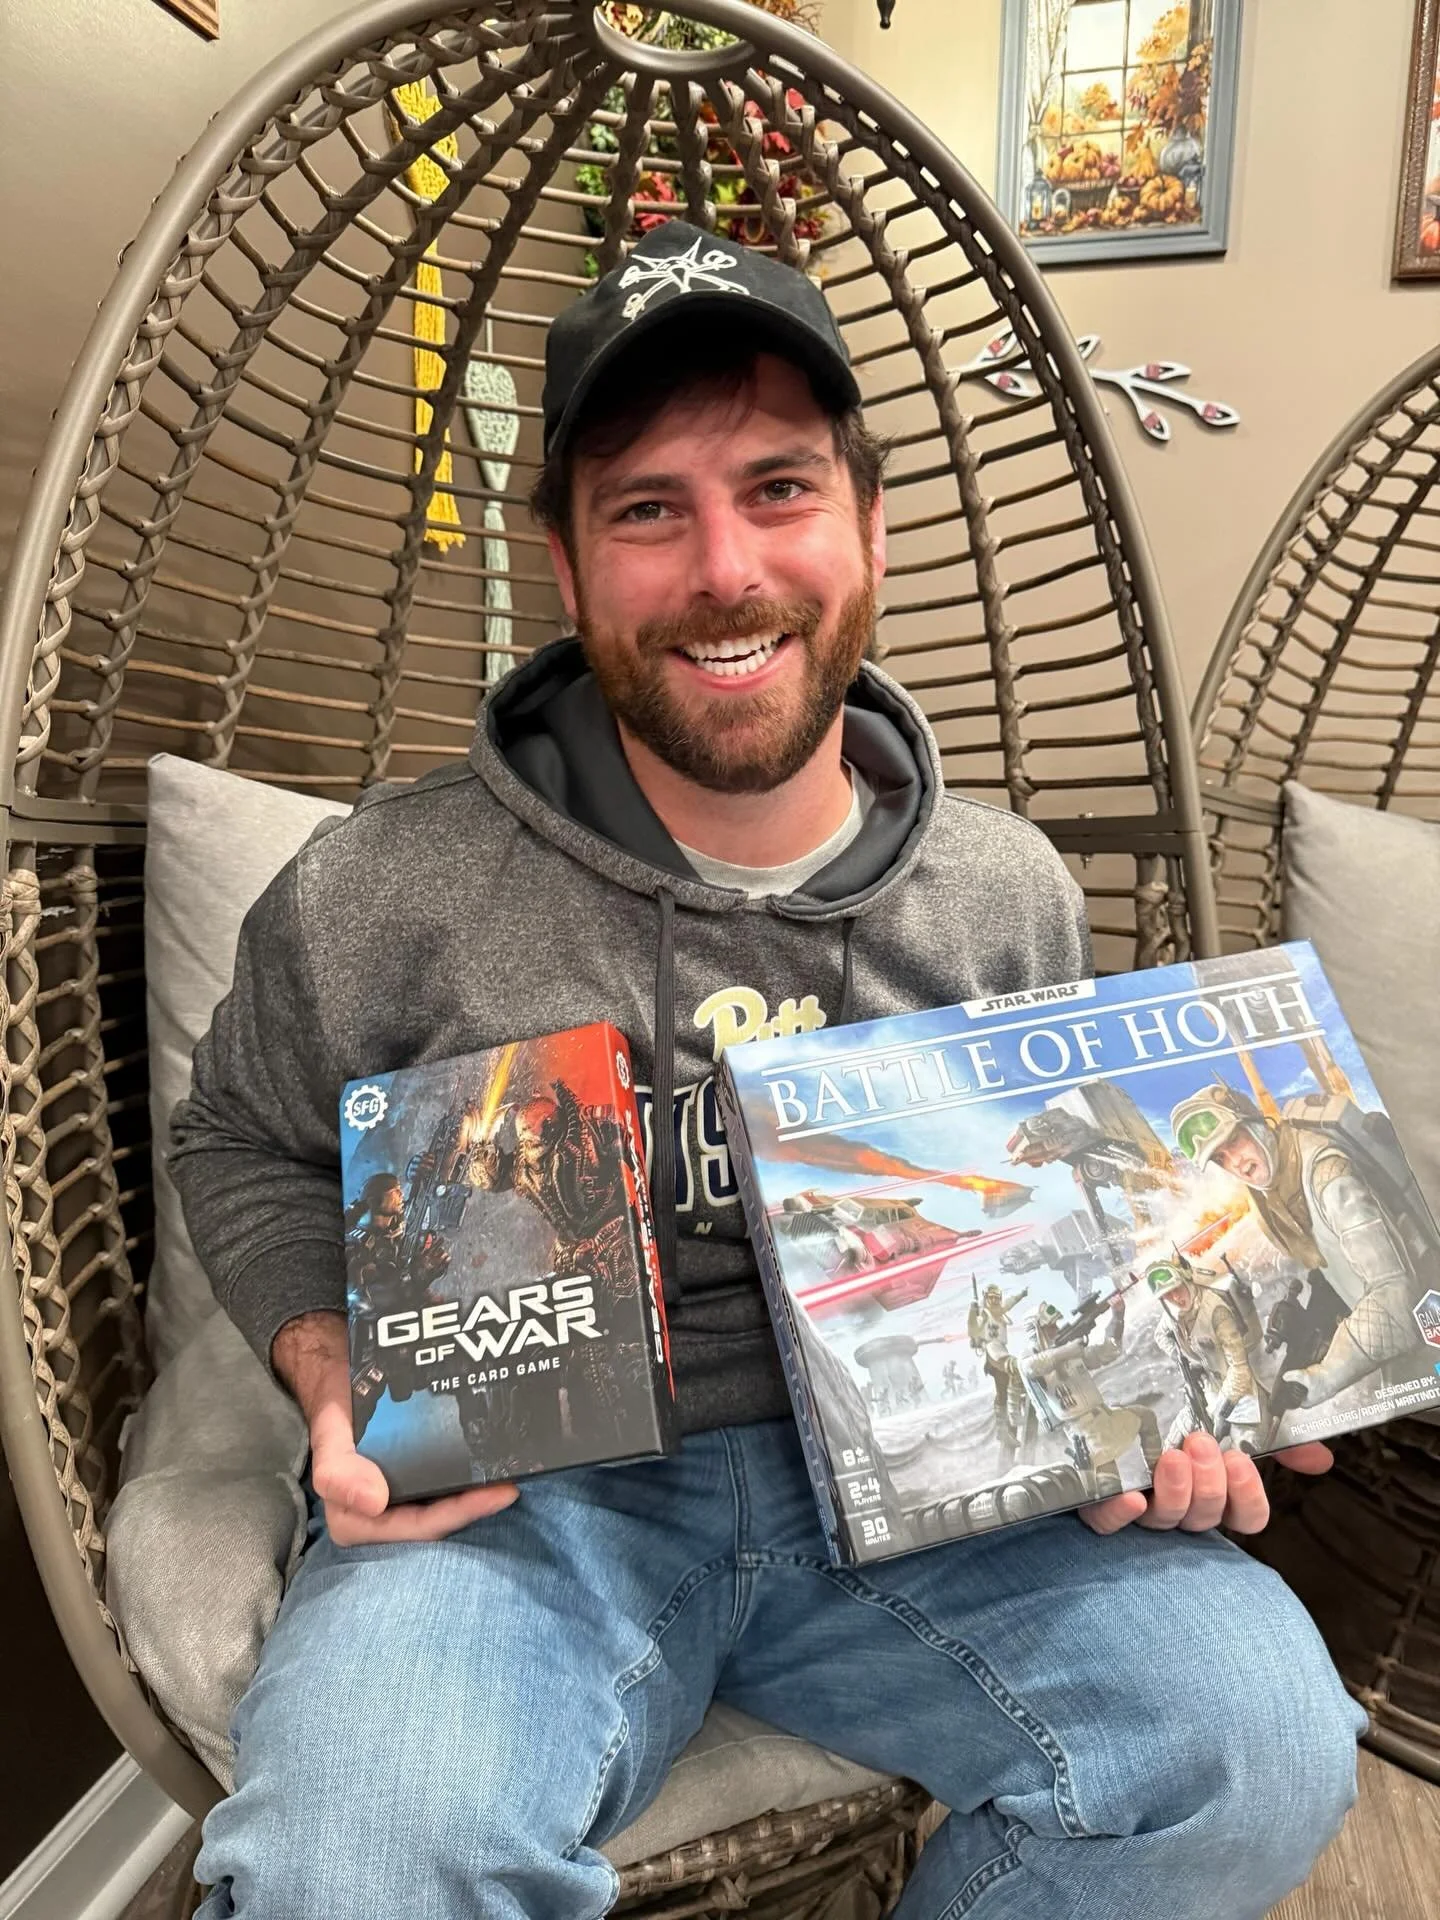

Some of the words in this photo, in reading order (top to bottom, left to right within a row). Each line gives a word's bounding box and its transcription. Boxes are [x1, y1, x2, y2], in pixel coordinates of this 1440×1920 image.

[981, 992, 1031, 1012] STAR
[1031, 984, 1079, 1002] WARS
[764, 1039, 1005, 1131] BATTLE
[1019, 1020, 1103, 1078] OF
[1118, 980, 1323, 1061] HOTH
[353, 1098, 380, 1117] SFG
[376, 1274, 594, 1347] GEARS
[415, 1343, 456, 1366] OF
[453, 1306, 603, 1362] WAR
[431, 1376, 460, 1393] THE
[467, 1367, 509, 1386] CARD
[516, 1356, 561, 1376] GAME
[1374, 1379, 1421, 1400] DESIGNED
[1420, 1375, 1437, 1388] BY:
[1290, 1417, 1332, 1437] RICHARD
[847, 1477, 880, 1500] 2-4
[861, 1516, 889, 1538] 30
